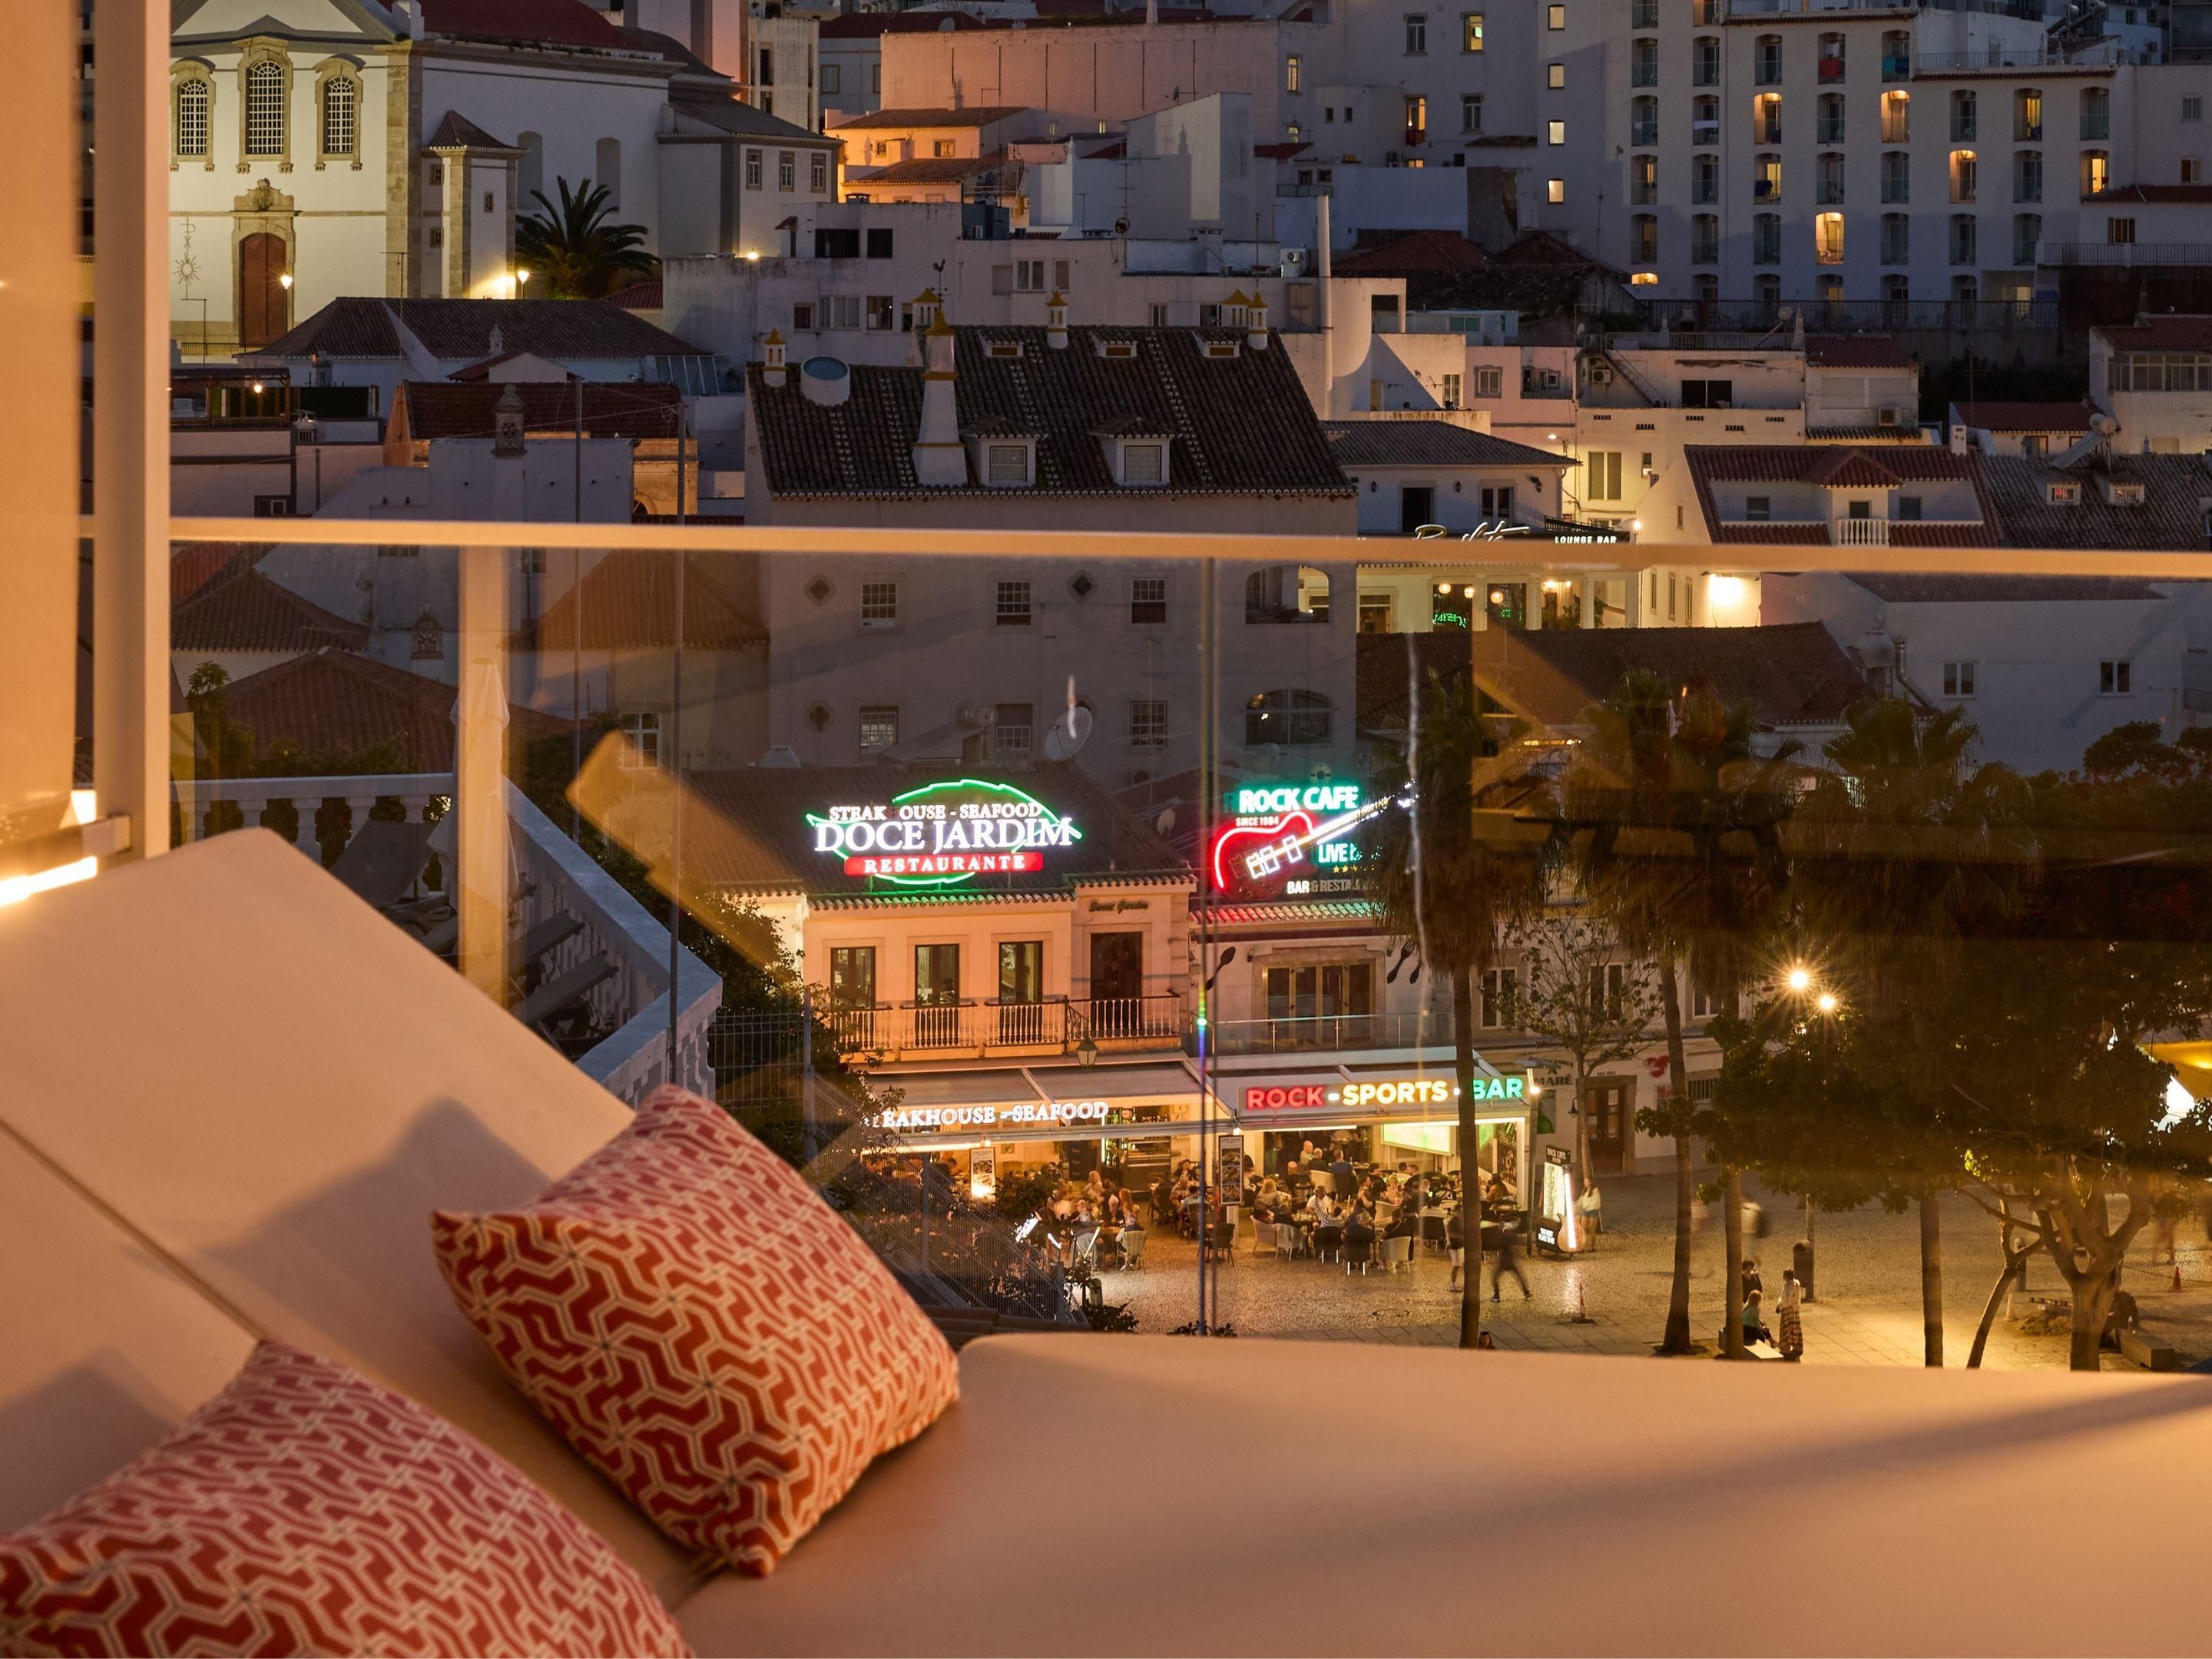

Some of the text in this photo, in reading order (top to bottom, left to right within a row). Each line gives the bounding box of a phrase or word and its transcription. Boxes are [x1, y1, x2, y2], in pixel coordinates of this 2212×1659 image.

[1554, 536, 1617, 545] LOUNGE BAR
[1239, 786, 1358, 813] ROCK CAFE
[960, 803, 1042, 819] SEAFOOD
[1236, 816, 1260, 827] SINCE
[814, 817, 1073, 855] DOCE JARDIM
[1318, 843, 1349, 863] LIVE
[864, 855, 1025, 873] RESTAURANTE
[1287, 881, 1310, 894] BAR
[1247, 1078, 1524, 1111] ROCK SPORTS BAR
[1012, 1101, 1108, 1124] SEAFOOD
